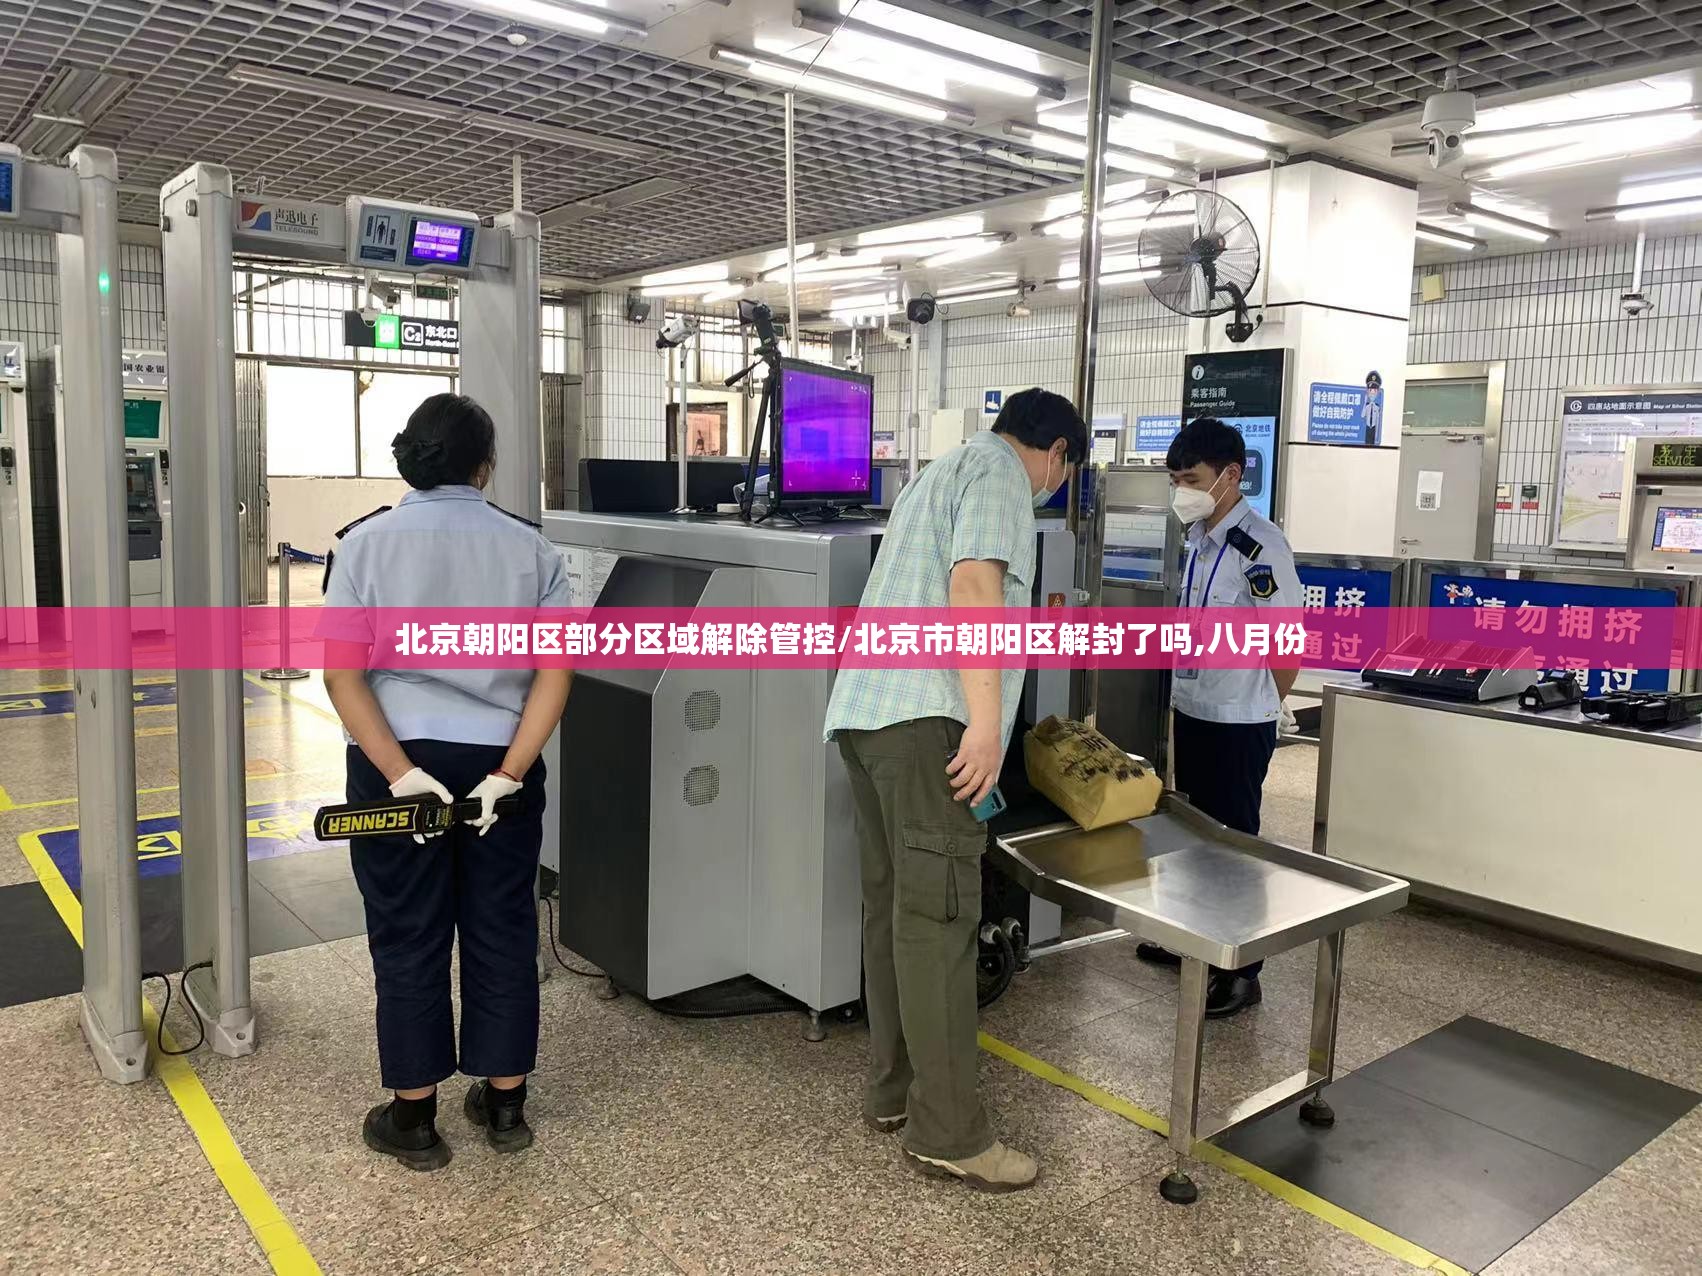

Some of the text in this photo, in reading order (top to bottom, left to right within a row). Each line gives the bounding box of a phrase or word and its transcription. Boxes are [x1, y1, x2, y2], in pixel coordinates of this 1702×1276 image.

[404, 326, 421, 342] C2
[1191, 387, 1227, 399] 乘客指南
[1219, 400, 1236, 408] Guide
[1654, 456, 1696, 466] SERVICE
[1473, 596, 1643, 645] 请勿拥挤
[328, 811, 410, 833] SCANNER
